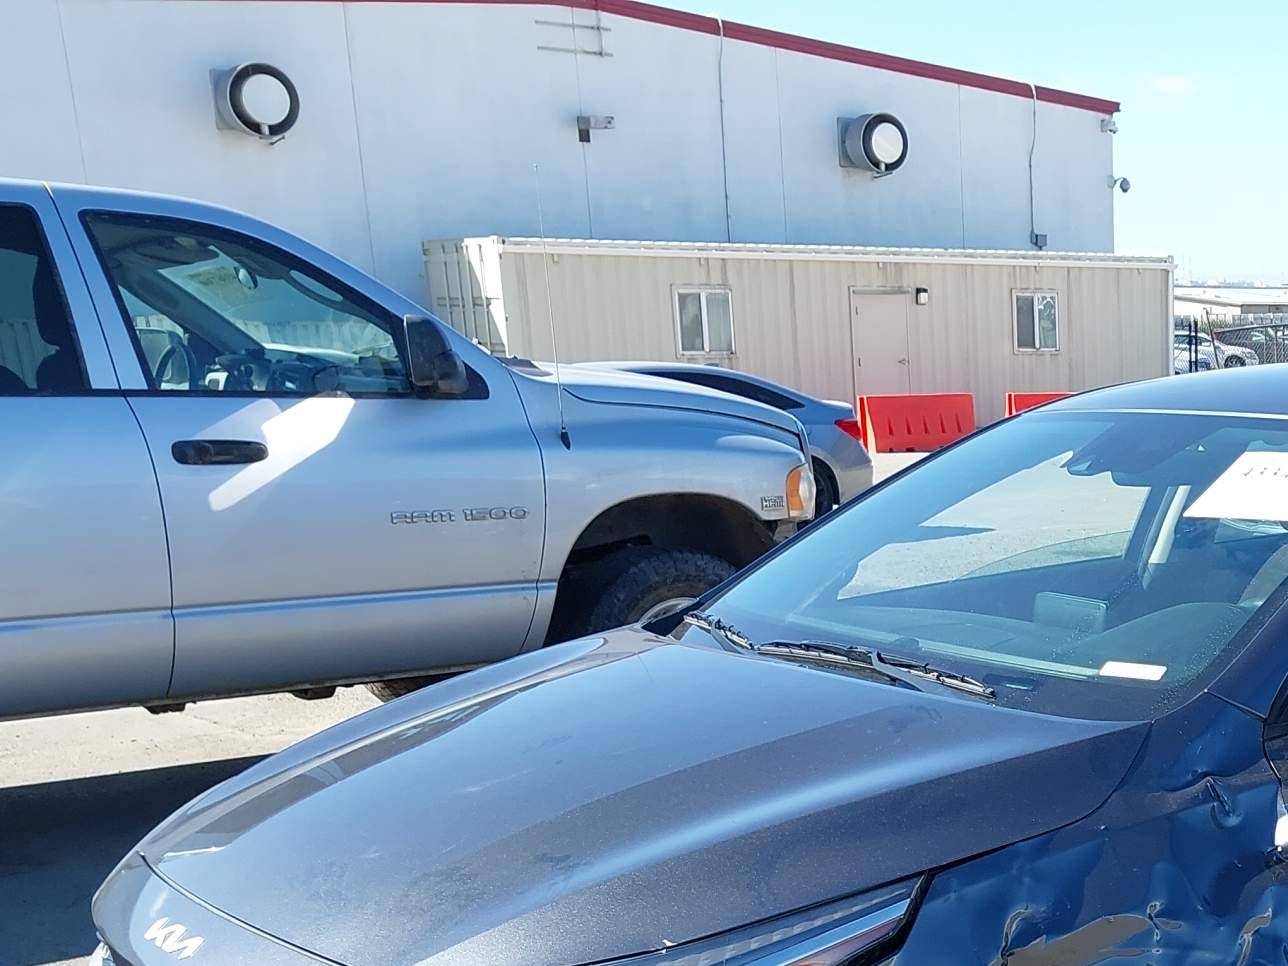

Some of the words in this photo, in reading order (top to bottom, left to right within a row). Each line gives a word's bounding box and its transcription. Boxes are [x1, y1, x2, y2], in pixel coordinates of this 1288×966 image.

[390, 509, 456, 525] RAM
[462, 506, 530, 523] 1500
[143, 916, 206, 960] KIA
